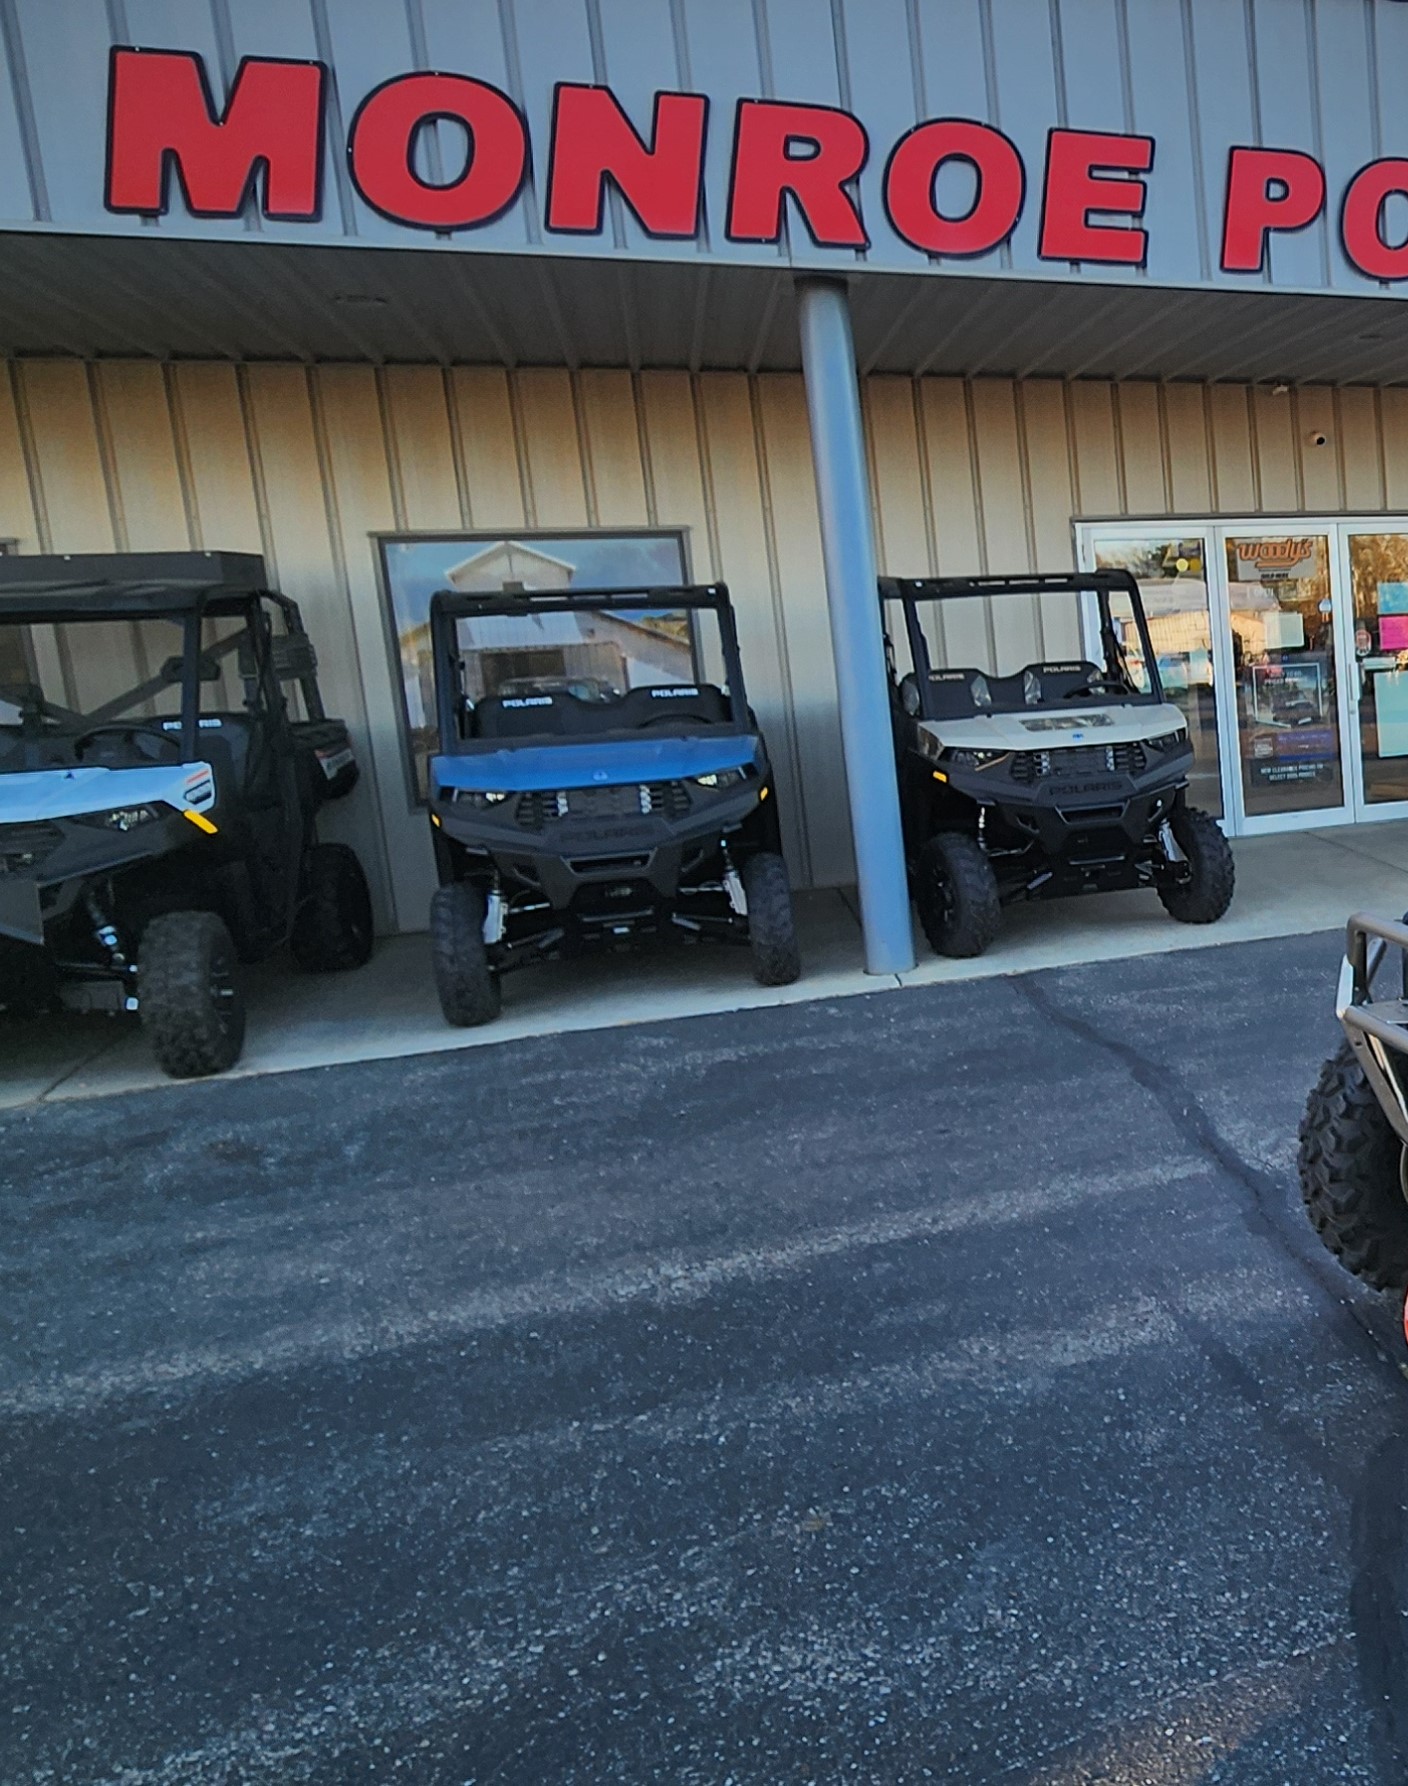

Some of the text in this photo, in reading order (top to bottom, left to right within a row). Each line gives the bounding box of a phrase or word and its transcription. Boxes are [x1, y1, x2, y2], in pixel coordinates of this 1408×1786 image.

[105, 46, 1155, 267] MONROE
[1043, 665, 1081, 673] POLARIS
[651, 688, 699, 698] POLARIS
[502, 697, 553, 708] POLARIS
